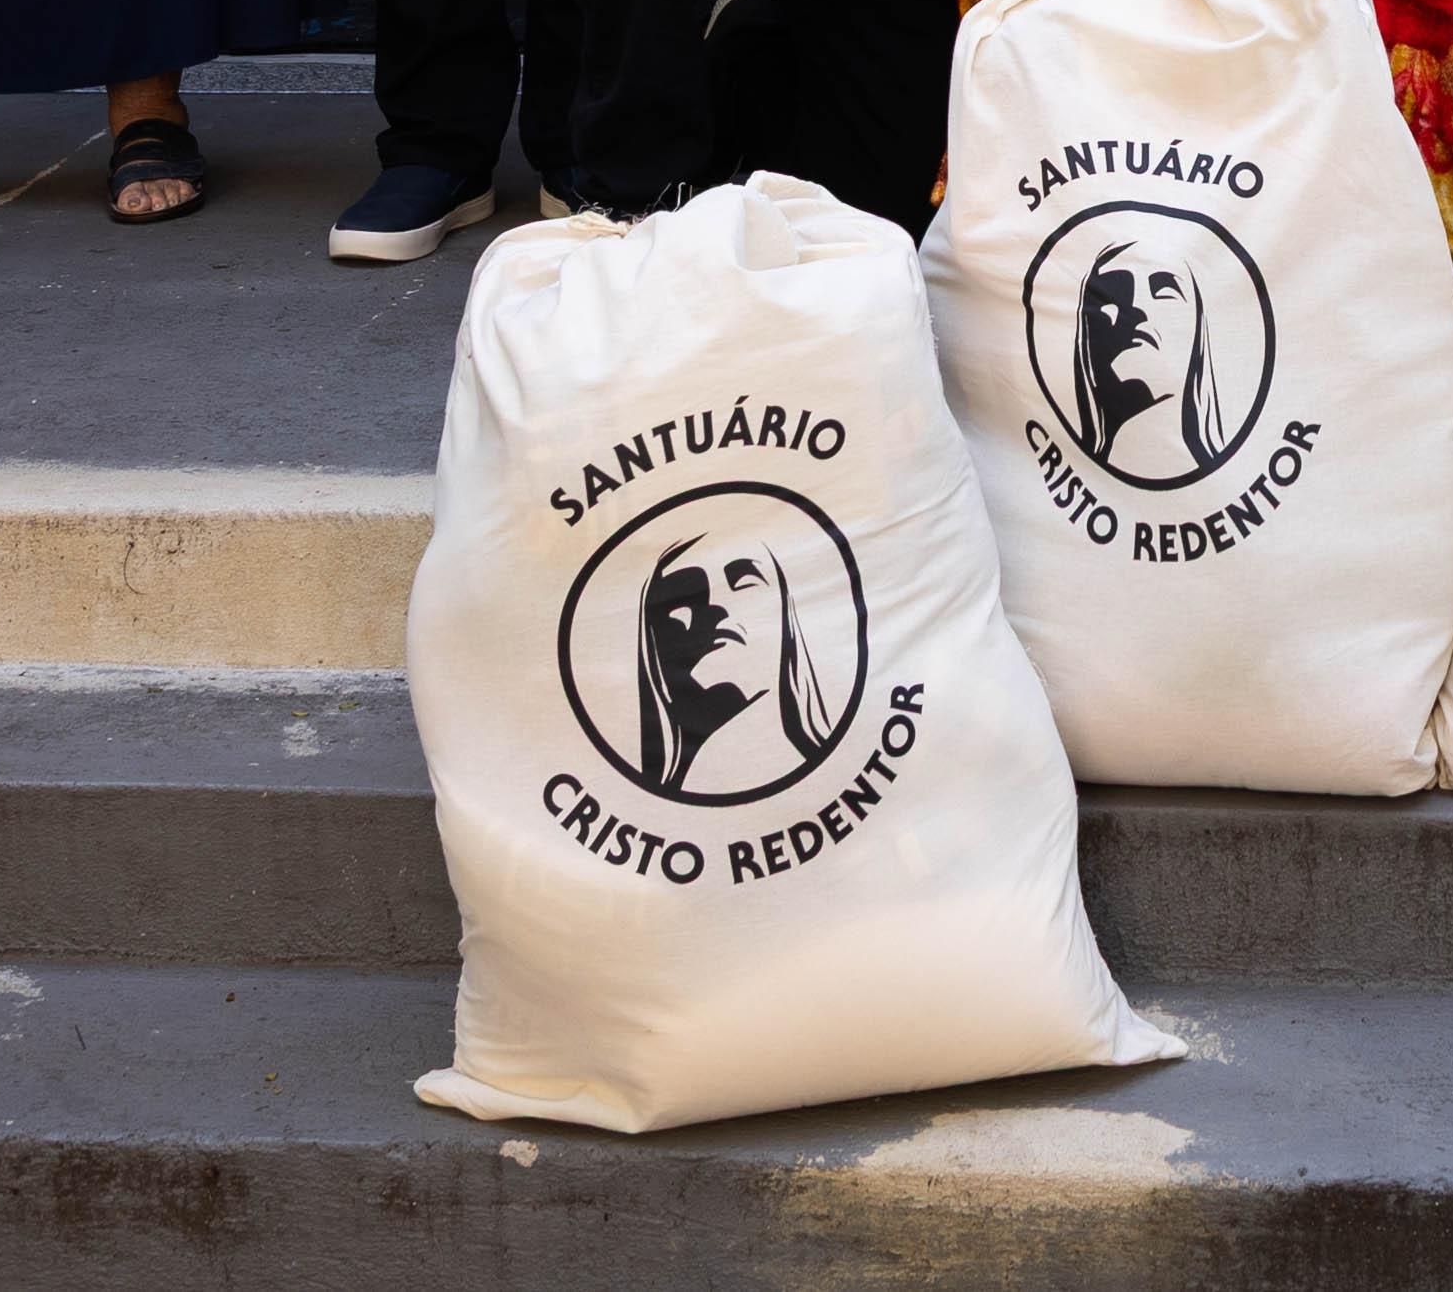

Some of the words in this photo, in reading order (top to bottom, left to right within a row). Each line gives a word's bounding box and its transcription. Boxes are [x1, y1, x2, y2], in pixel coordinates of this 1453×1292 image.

[1017, 138, 1265, 213] SANTUÁRIO
[549, 394, 847, 528] SANTUÁRIO
[1024, 418, 1119, 546] CRISTO
[1132, 419, 1323, 564] REDENTOR
[542, 773, 706, 886] CRISTO
[728, 682, 926, 886] REDENTOR
